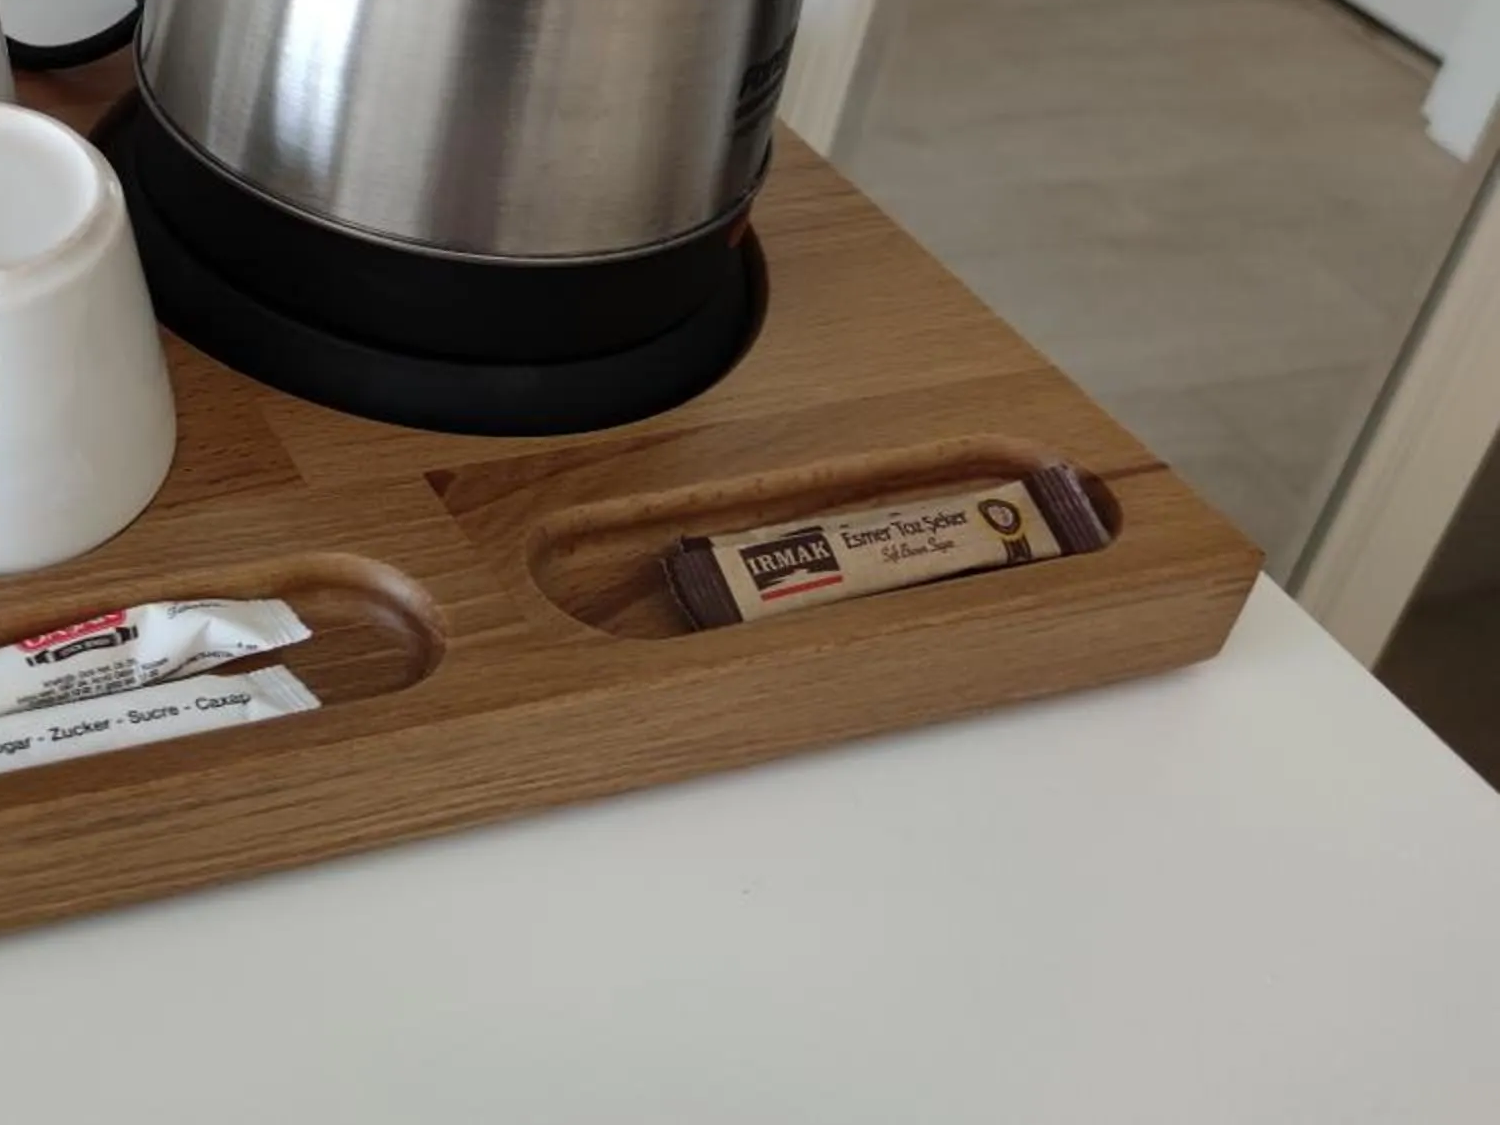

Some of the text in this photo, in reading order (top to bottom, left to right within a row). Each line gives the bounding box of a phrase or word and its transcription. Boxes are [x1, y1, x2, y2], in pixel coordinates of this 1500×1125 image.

[746, 541, 831, 575] IRMAK
[49, 718, 110, 743] Zucker
[128, 706, 180, 725] Sucre
